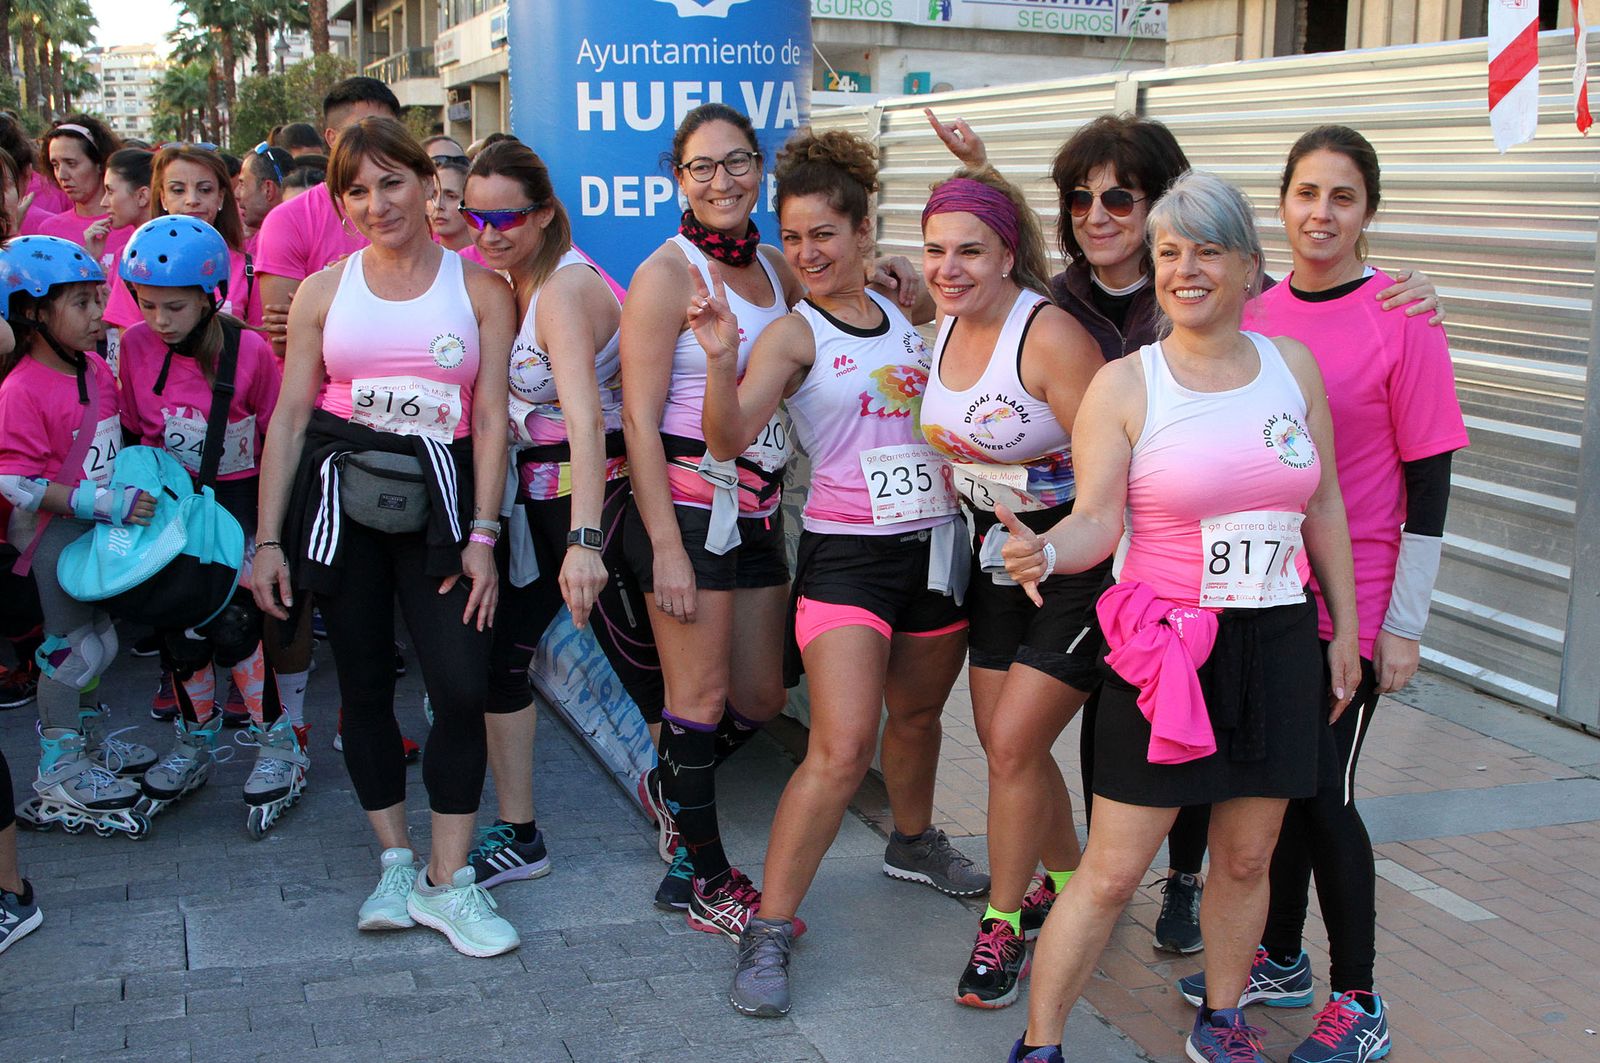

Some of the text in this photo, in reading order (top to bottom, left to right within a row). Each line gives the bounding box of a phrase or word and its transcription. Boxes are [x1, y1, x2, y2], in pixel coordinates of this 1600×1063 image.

[811, 0, 893, 18] GUROS
[1017, 9, 1113, 32] SEGUROS
[576, 37, 801, 73] Ayuntamiento de
[357, 389, 420, 417] 316
[964, 393, 1031, 424] DIOSAS ALADAS
[969, 432, 1026, 450] RUNNER CLUB
[1263, 414, 1278, 448] DIOSAS
[170, 433, 205, 457] 24
[879, 453, 911, 463] Carrera
[1279, 454, 1307, 468] RUNNER
[870, 464, 932, 499] 235
[1000, 472, 1022, 481] Mujer
[1224, 522, 1265, 532] Carrera
[1268, 521, 1277, 531] de
[1208, 540, 1281, 576] 817
